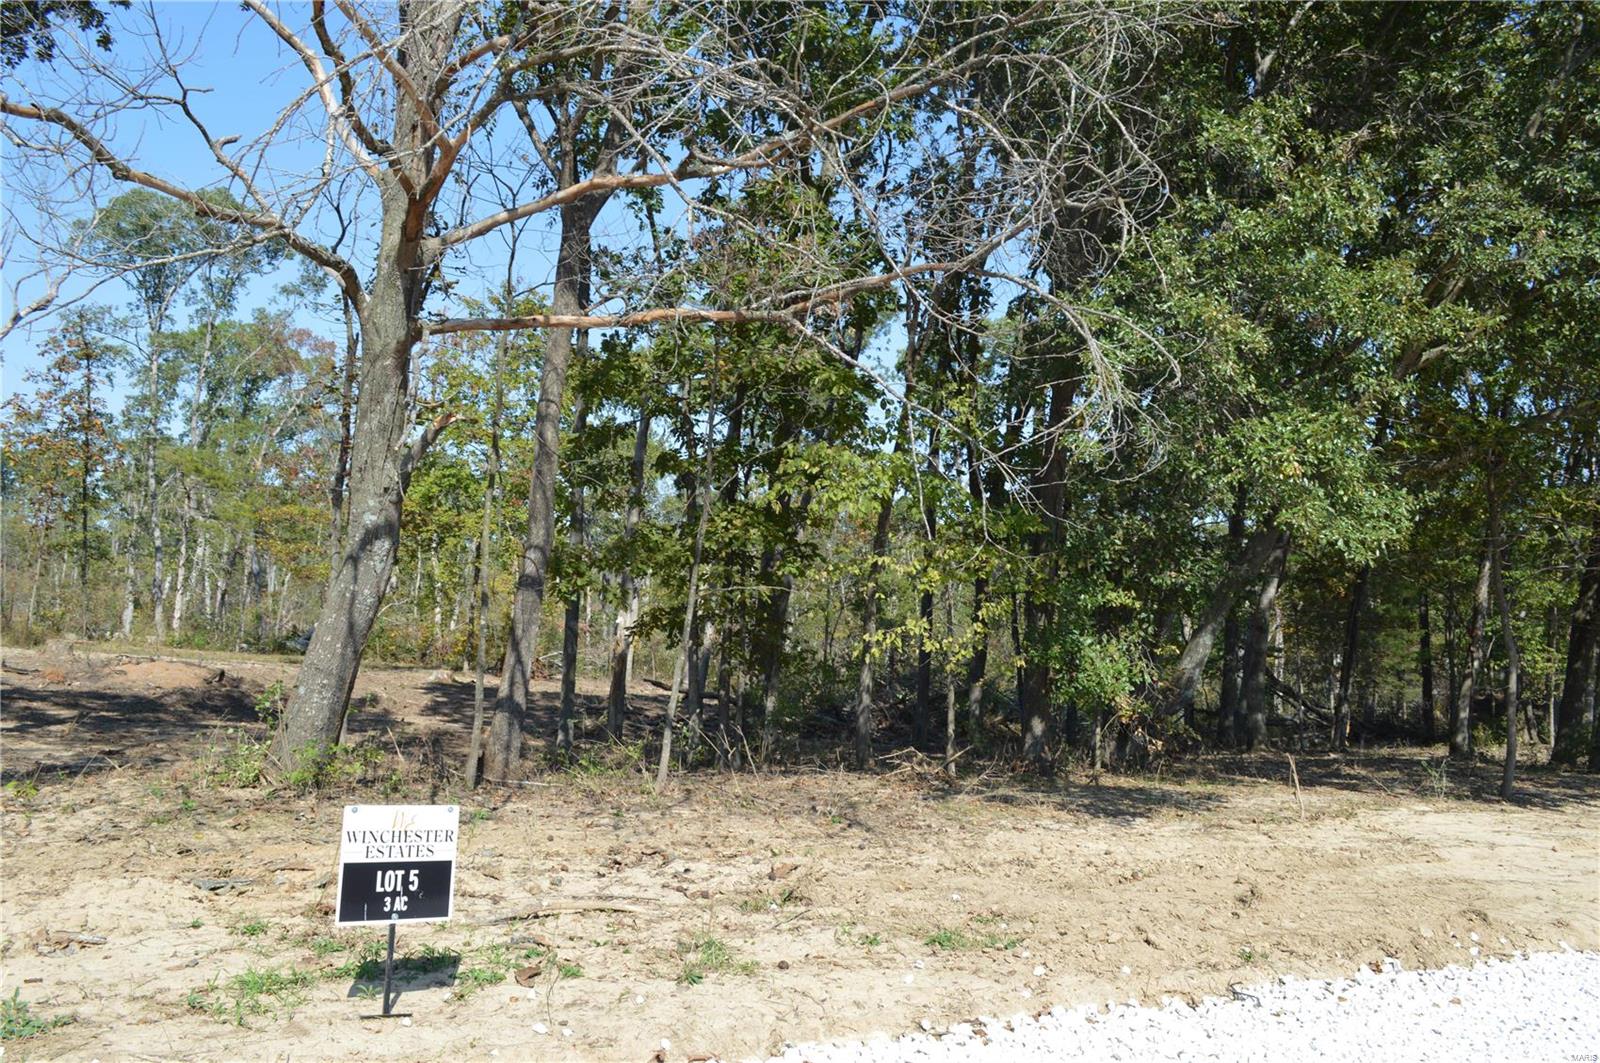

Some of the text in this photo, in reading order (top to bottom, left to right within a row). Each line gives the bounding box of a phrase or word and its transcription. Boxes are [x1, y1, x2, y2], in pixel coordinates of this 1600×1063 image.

[346, 830, 454, 844] WINCHESTER
[366, 845, 434, 859] ESTATES
[375, 869, 419, 892] LOT 5
[383, 895, 408, 912] 3 AC
